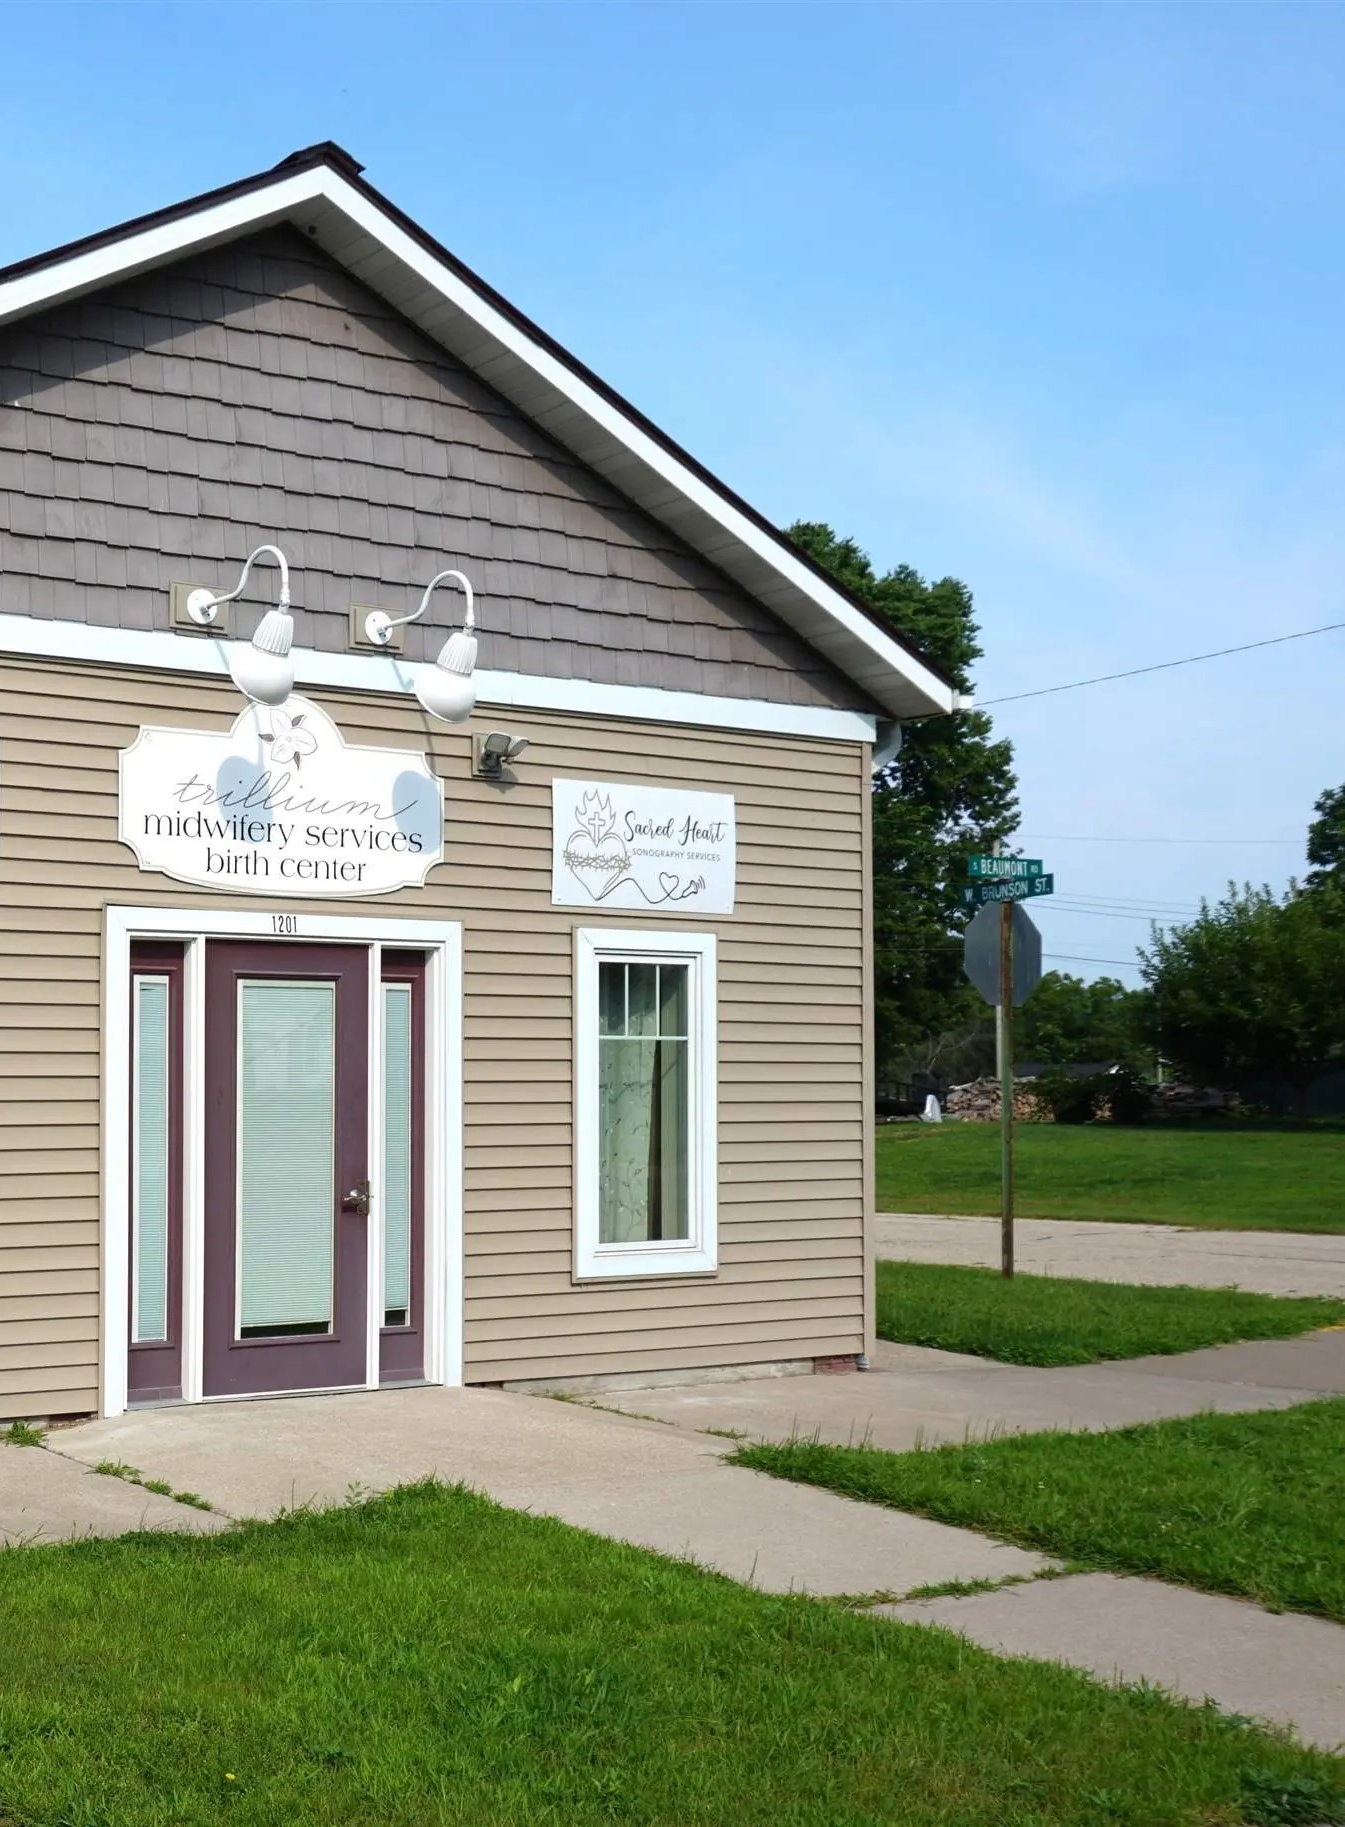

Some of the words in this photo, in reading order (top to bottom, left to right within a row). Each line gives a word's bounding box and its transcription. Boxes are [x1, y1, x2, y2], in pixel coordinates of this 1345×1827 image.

[173, 770, 418, 820] trillium
[144, 811, 295, 850] midwifery
[305, 824, 423, 853] services
[623, 810, 675, 842] Sacred
[678, 815, 728, 847] Heart
[206, 847, 270, 876] birth
[280, 856, 367, 882] center
[632, 847, 685, 858] SONOGRAPHY
[686, 851, 721, 862] SERVICES
[981, 858, 1027, 876] BEAUMONT
[982, 880, 1029, 900] BRUNSON
[1035, 877, 1050, 892] ST.
[272, 915, 298, 933] 1201
